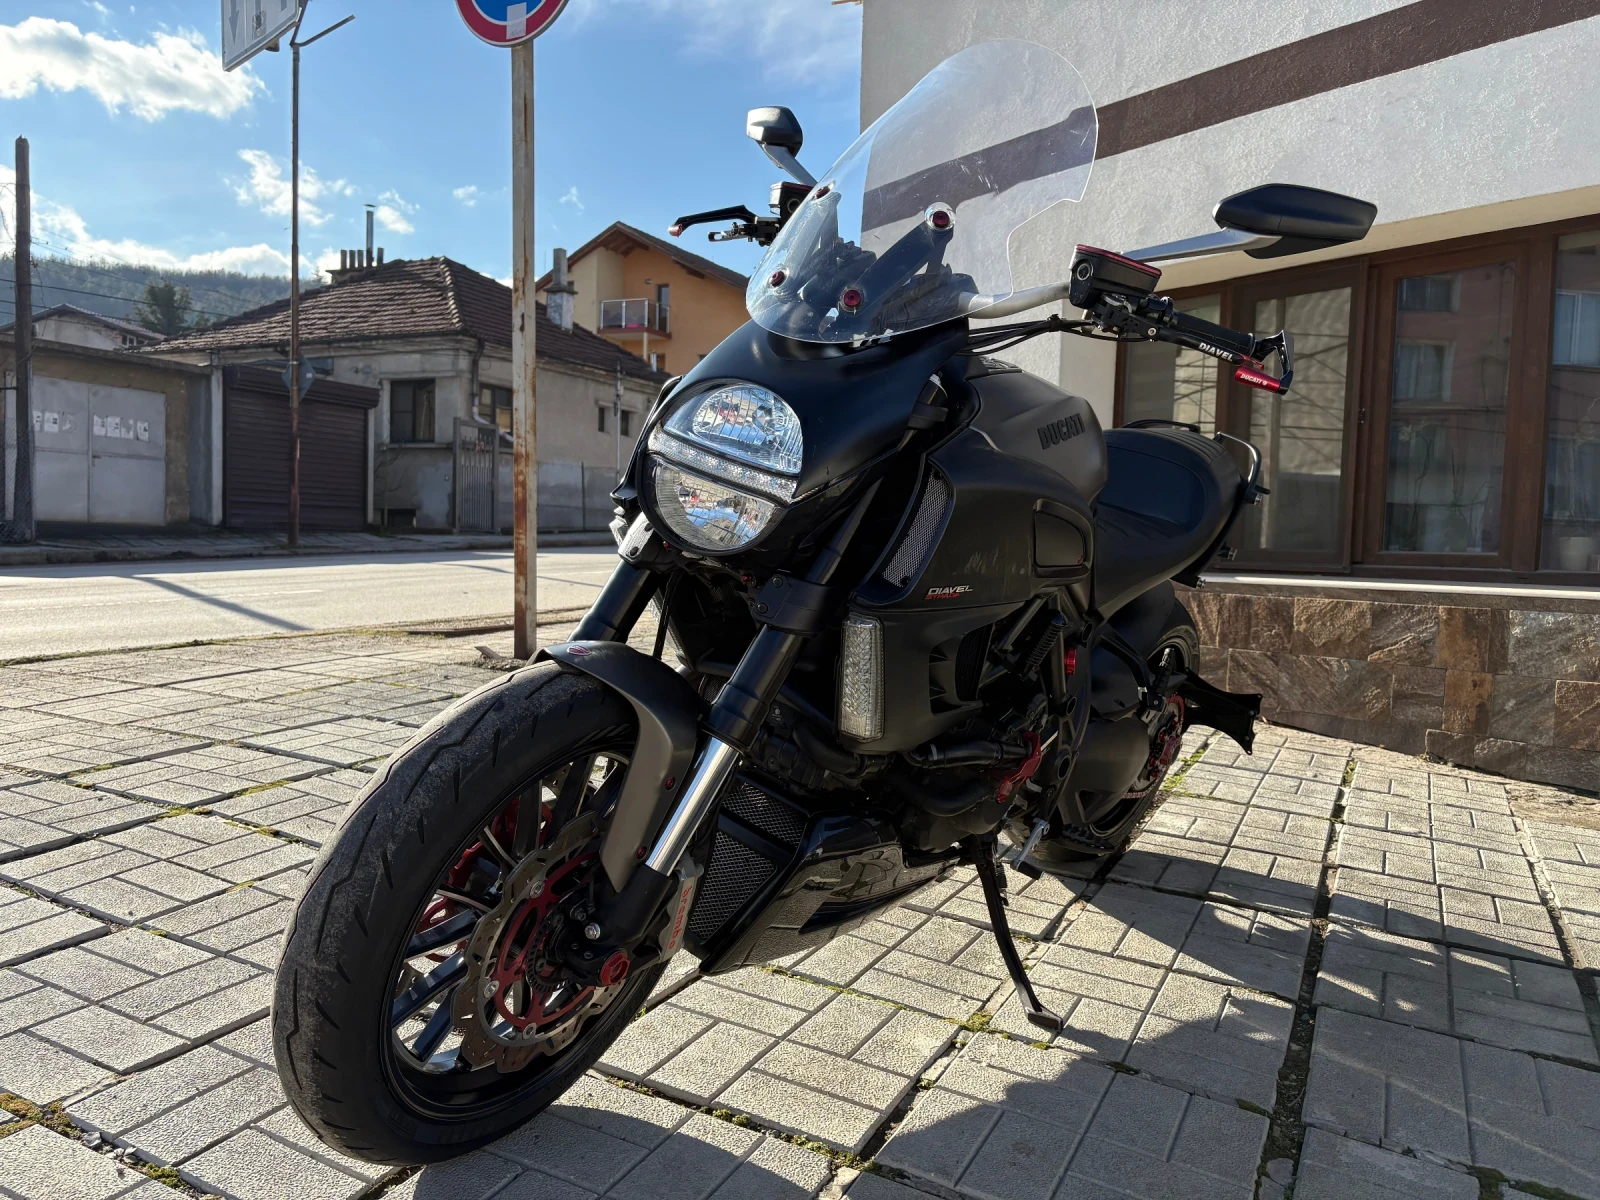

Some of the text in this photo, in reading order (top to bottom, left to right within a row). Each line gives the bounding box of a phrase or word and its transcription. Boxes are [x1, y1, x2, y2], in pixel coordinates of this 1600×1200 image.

[1199, 342, 1233, 362] DIAVEL
[1240, 374, 1262, 385] DUCATI
[1037, 413, 1085, 450] DUCATI
[927, 585, 974, 595] DIAVEL
[668, 885, 692, 949] brembo
